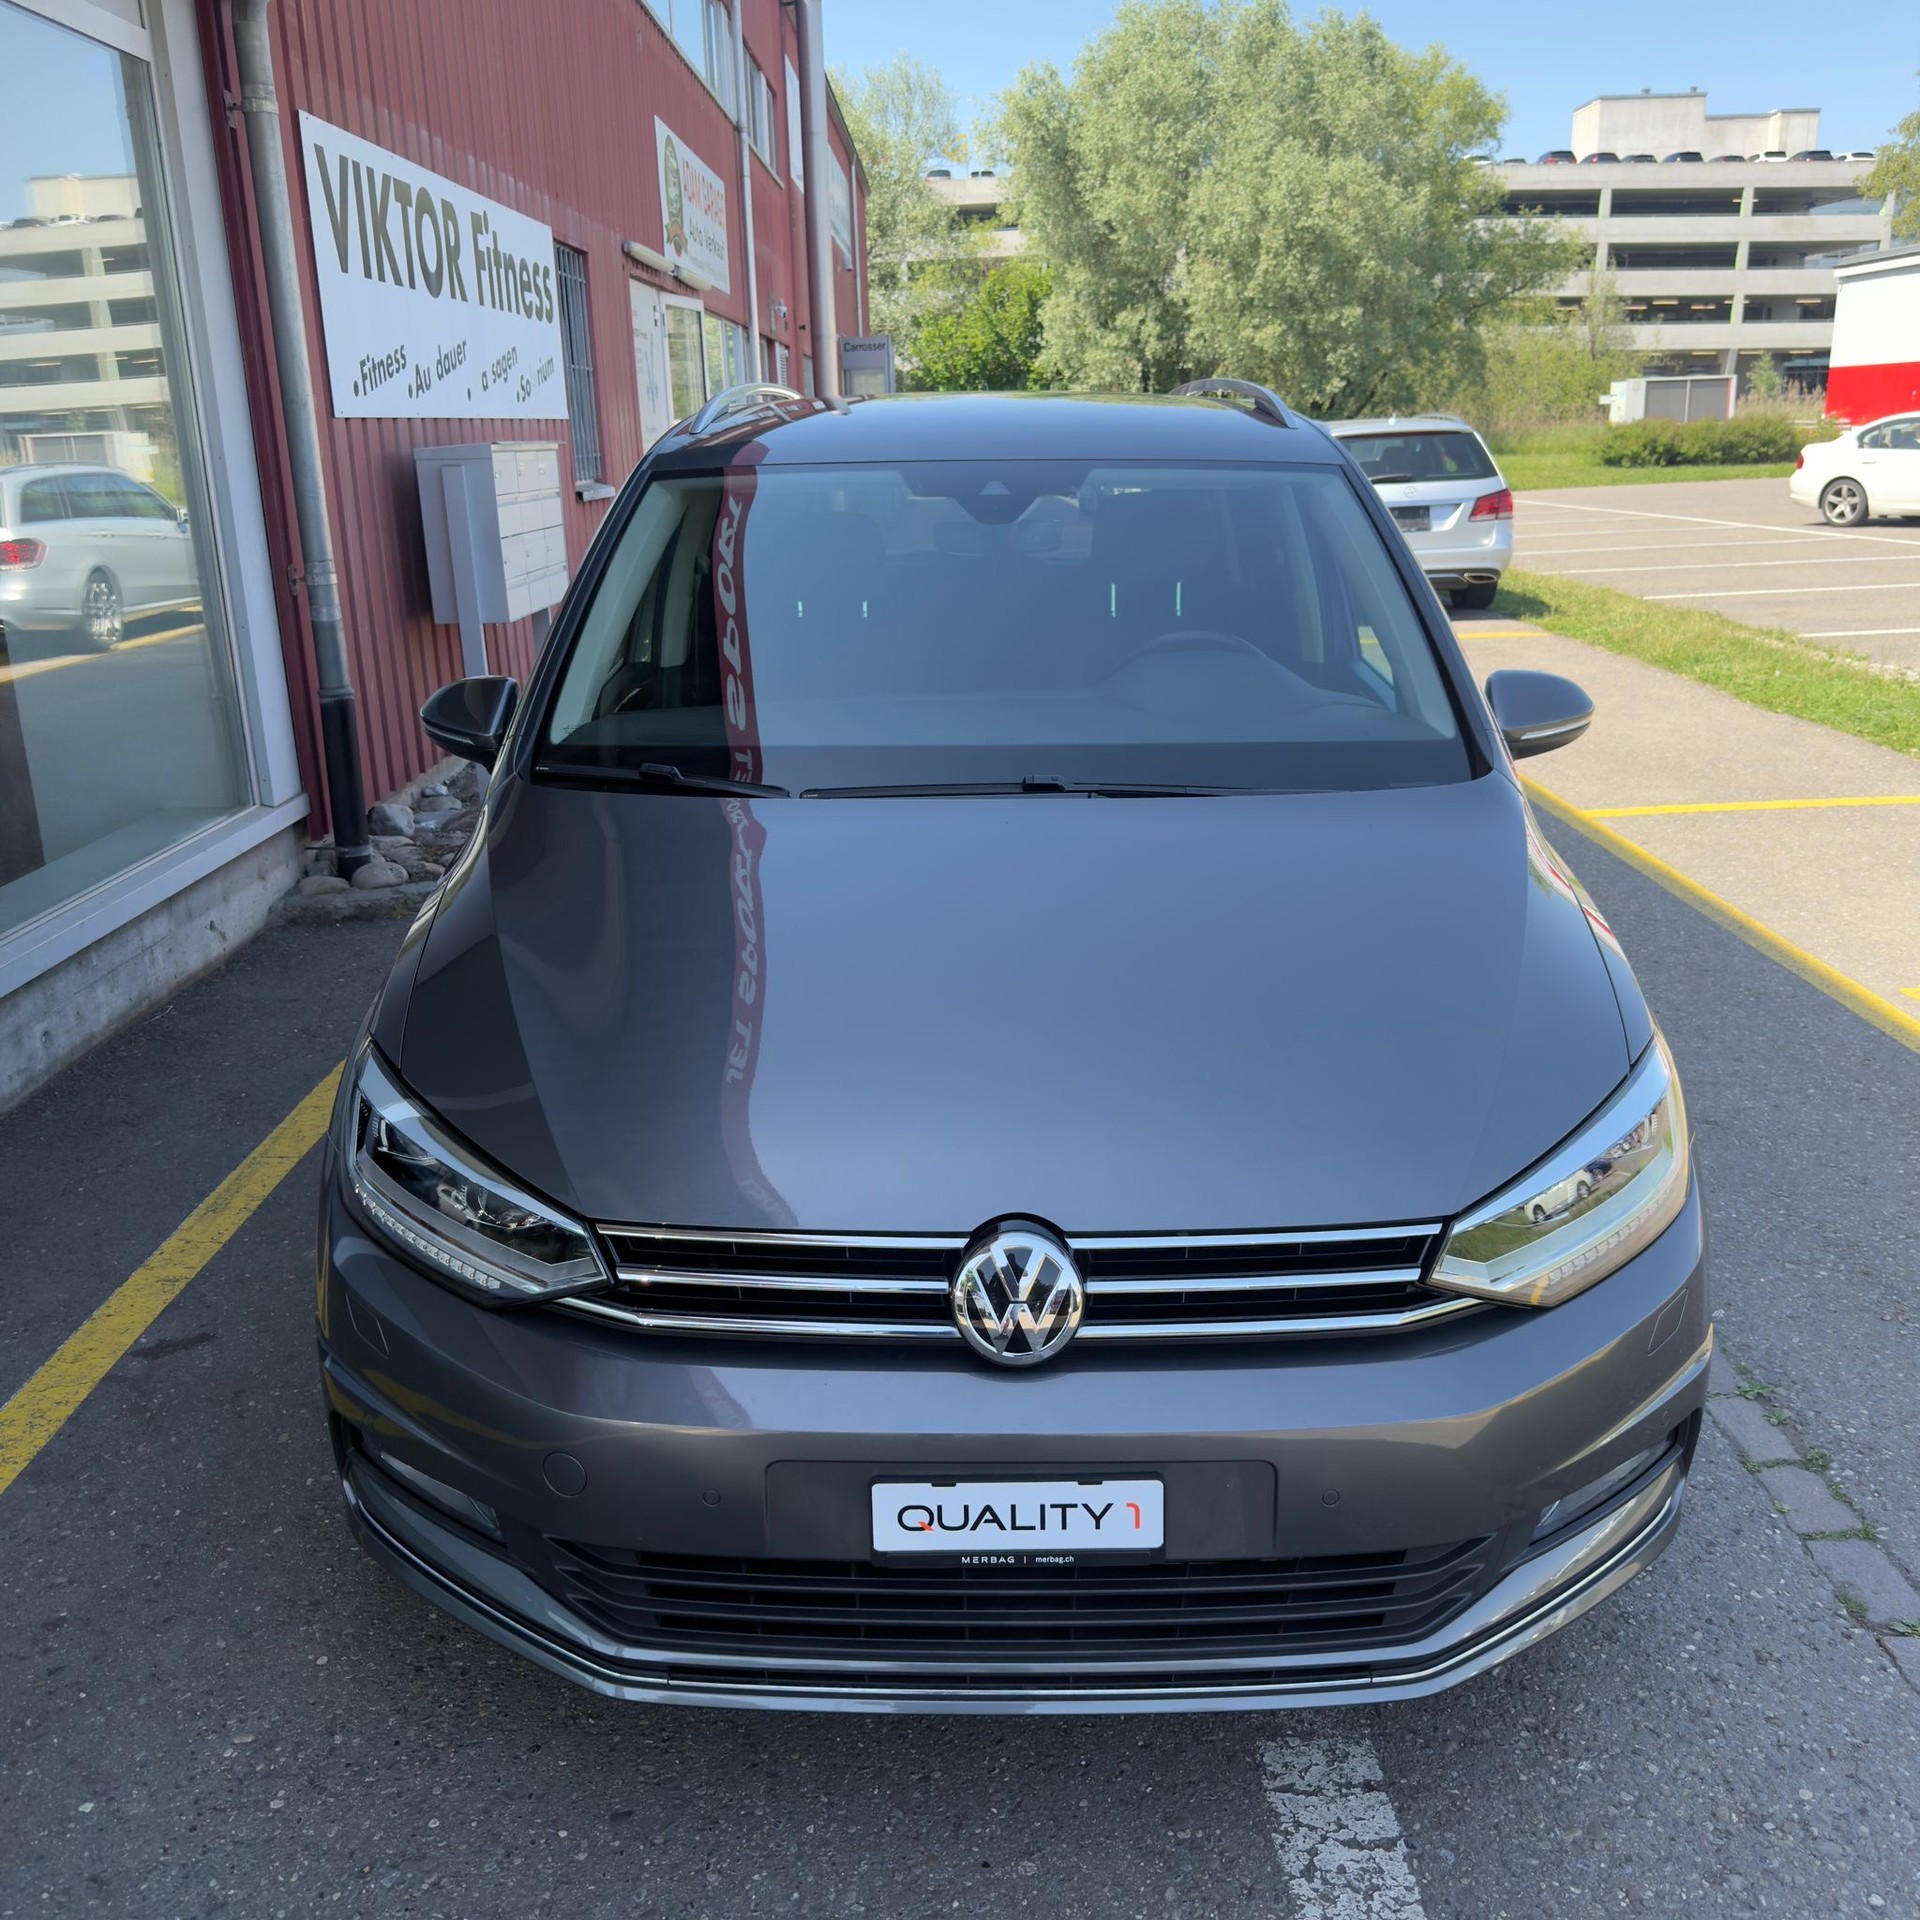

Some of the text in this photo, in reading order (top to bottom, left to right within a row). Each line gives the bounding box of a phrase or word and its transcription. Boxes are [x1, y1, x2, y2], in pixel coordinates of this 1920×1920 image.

[313, 143, 554, 324] VIKTOR Fitness
[359, 344, 407, 396] Fitness
[897, 1503, 1114, 1532] QUALITY
[961, 1555, 1075, 1564] MERBAG merbag.ch
